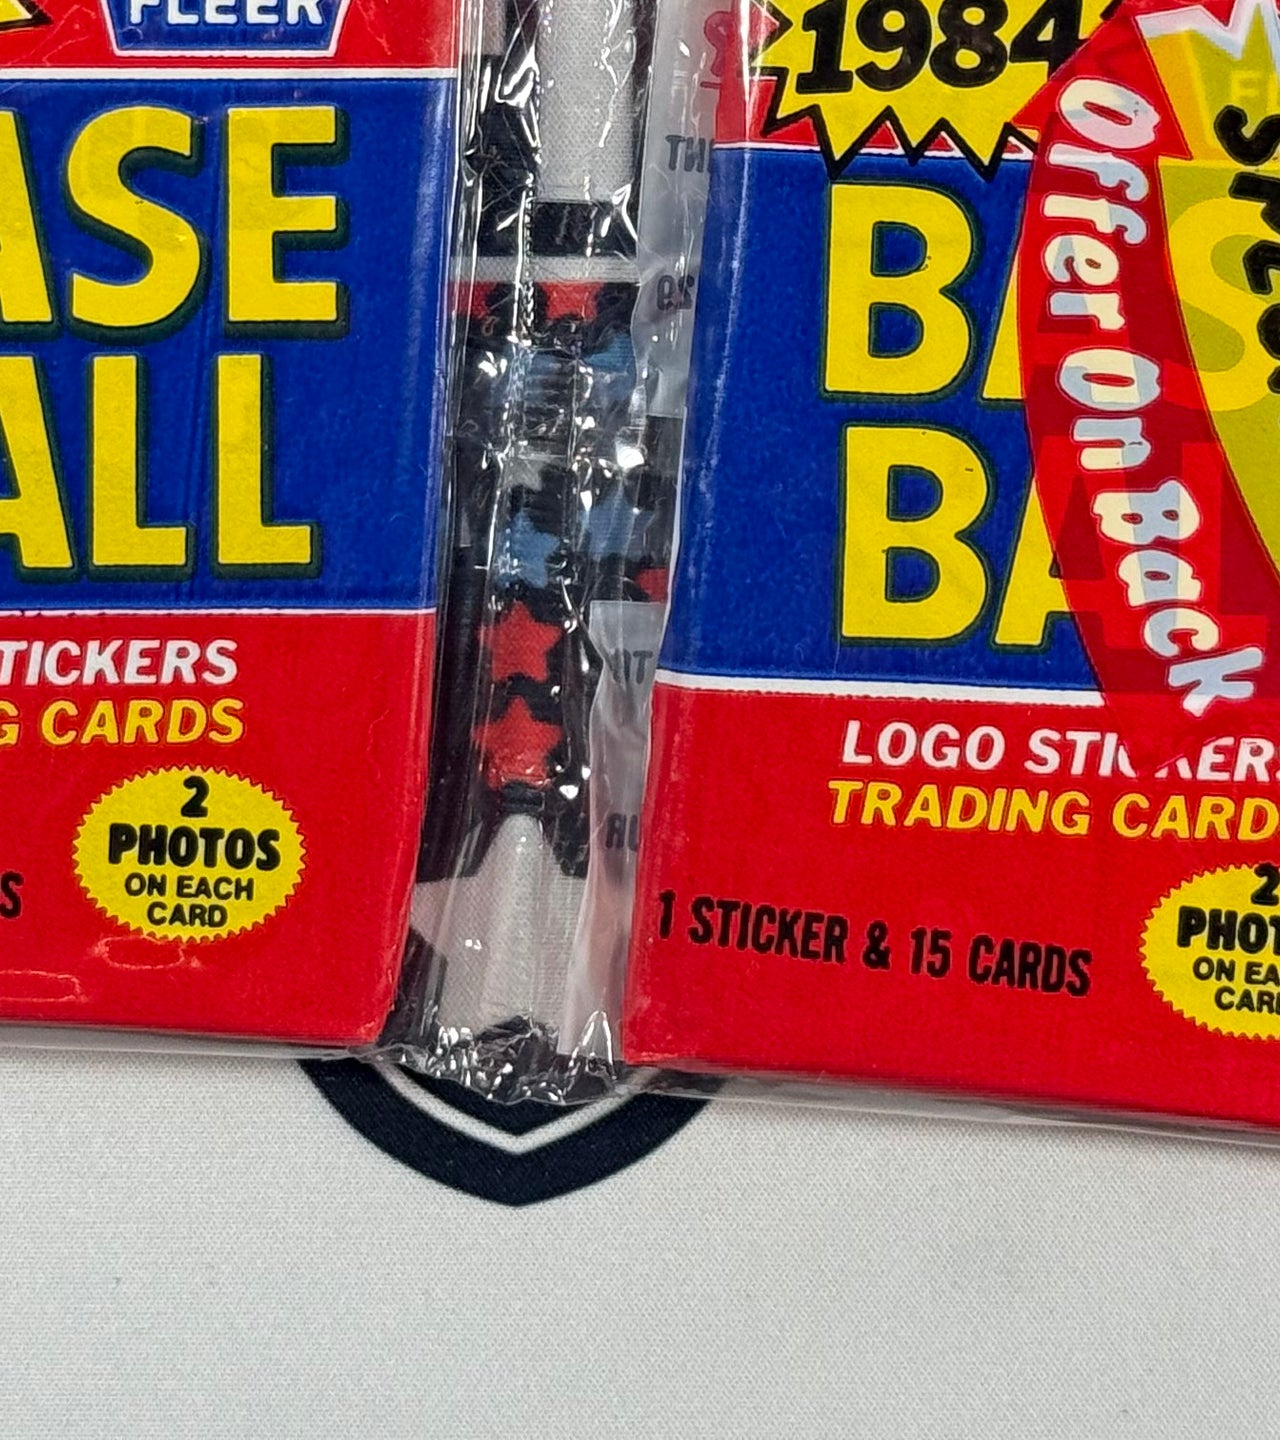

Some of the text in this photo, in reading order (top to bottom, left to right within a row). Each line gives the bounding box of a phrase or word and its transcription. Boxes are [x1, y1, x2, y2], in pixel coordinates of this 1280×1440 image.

[1043, 77, 1264, 717] Offer On Back
[42, 698, 244, 745] CARDS
[843, 719, 1004, 772] LOGO
[180, 776, 209, 818] 2
[827, 780, 1090, 836] TRADING
[108, 823, 280, 870] PHOTOS
[124, 873, 255, 900] ON EACH
[1251, 864, 1280, 905] 2
[147, 902, 228, 928] CARD
[658, 891, 1093, 998] 1 STICKER & 15 CARDS
[1193, 957, 1236, 984] ON
